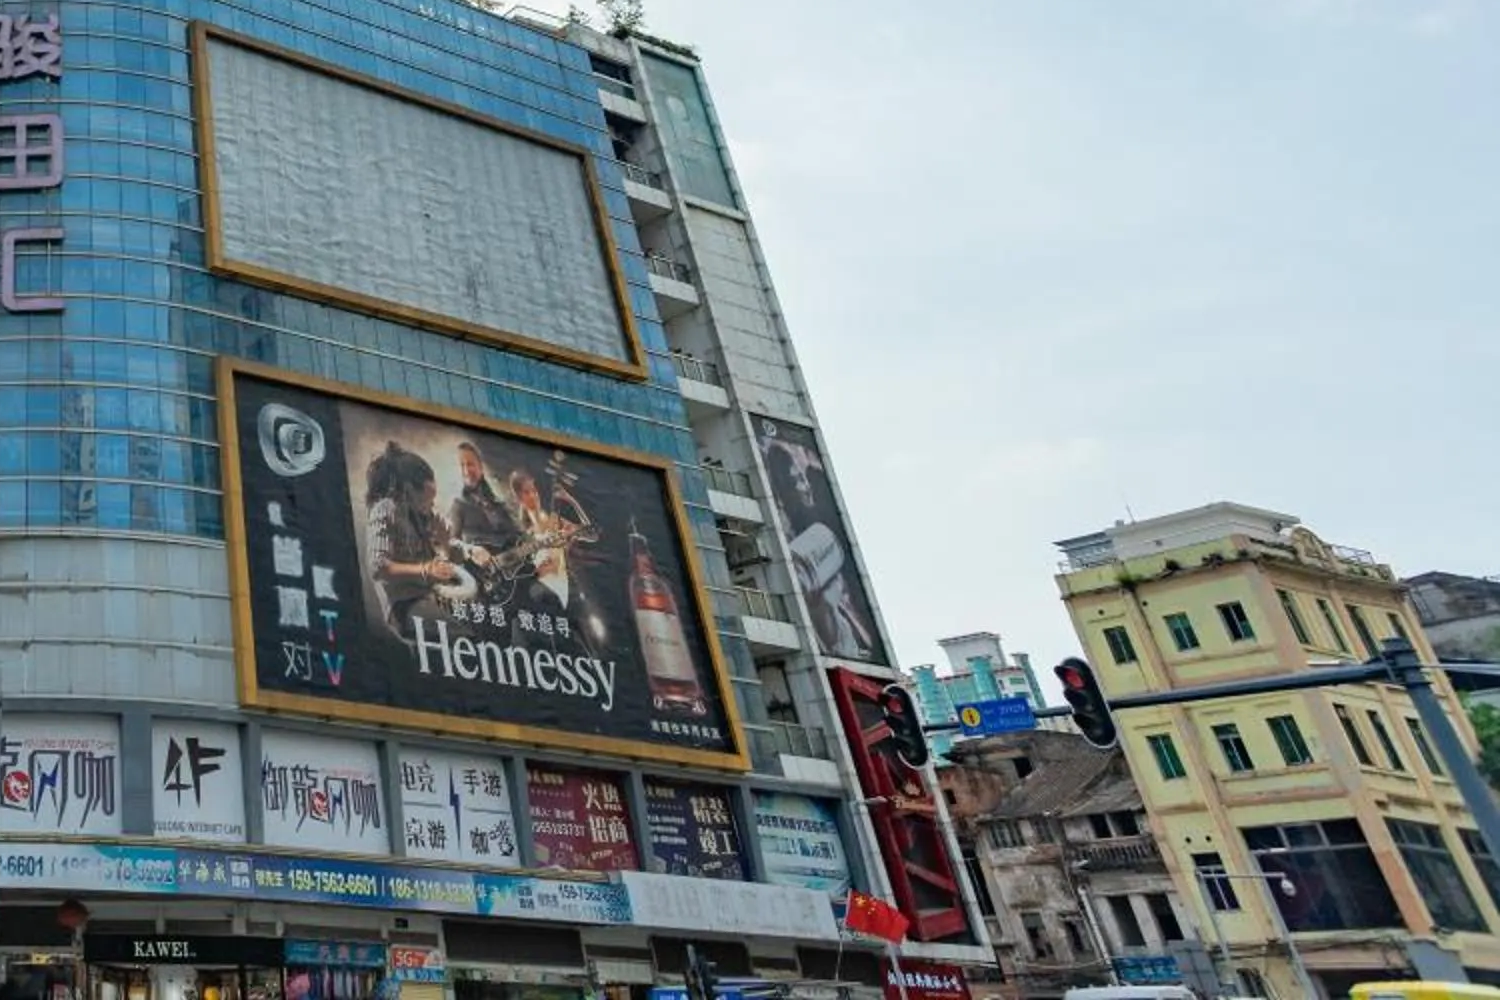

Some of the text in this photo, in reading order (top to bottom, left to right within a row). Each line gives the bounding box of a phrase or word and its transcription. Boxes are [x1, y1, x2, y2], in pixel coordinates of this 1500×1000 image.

[411, 615, 616, 712] Hennessy
[133, 941, 190, 958] KAWEI
[395, 950, 413, 967] 5G
